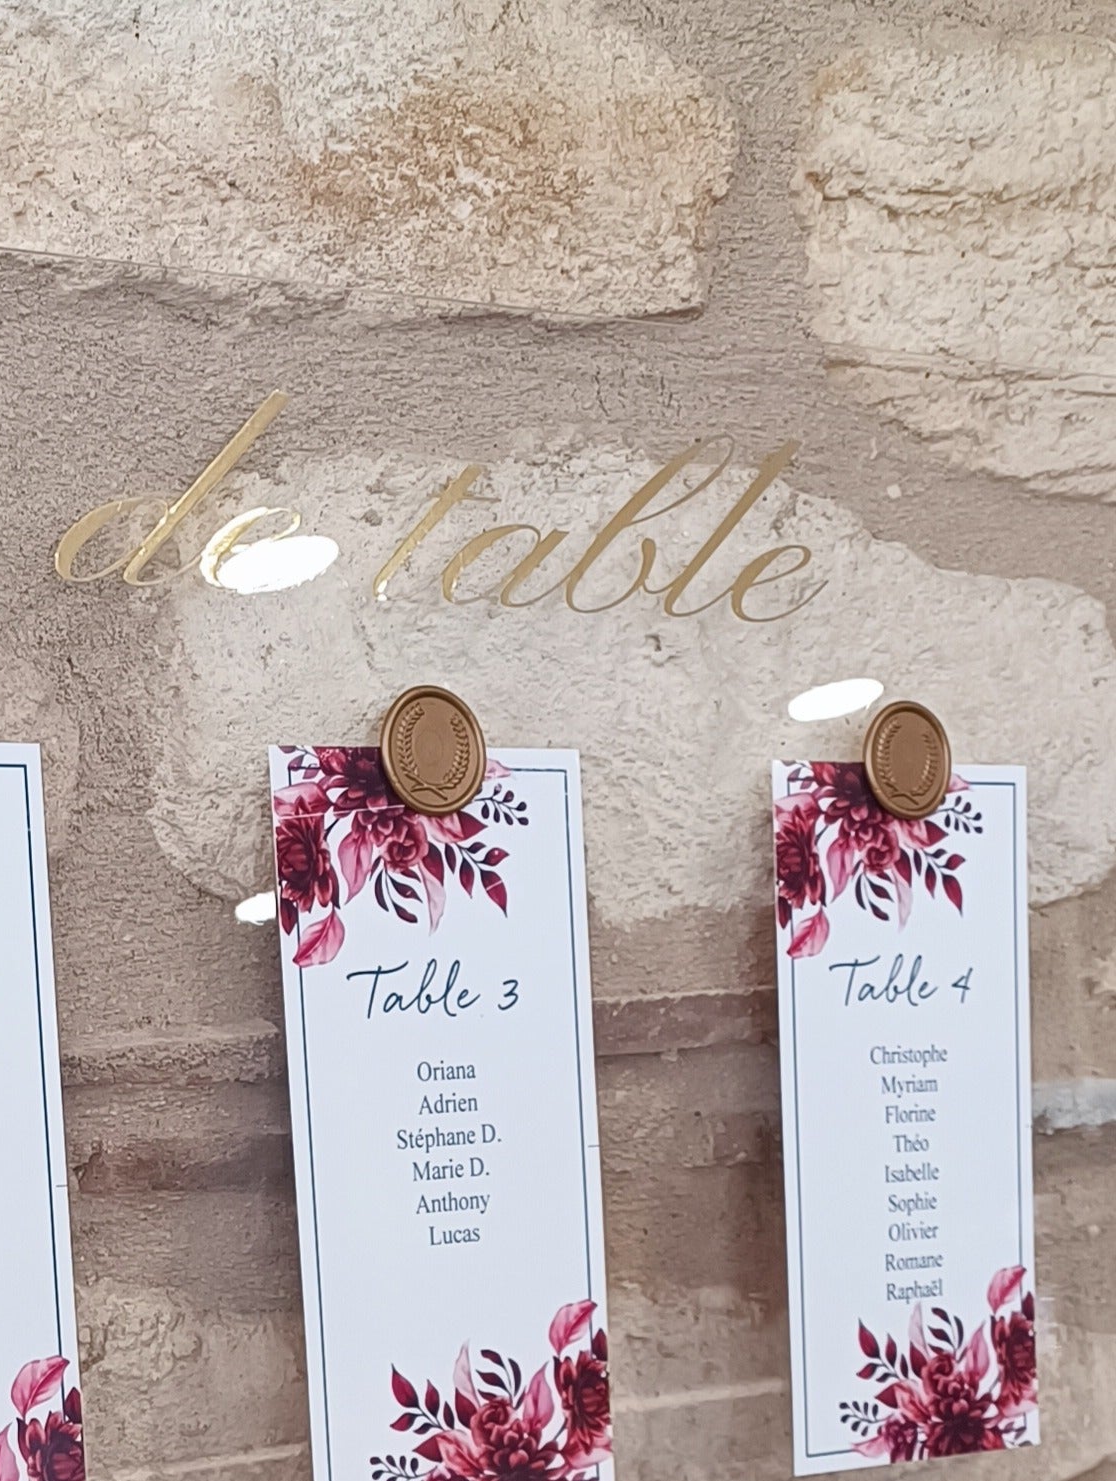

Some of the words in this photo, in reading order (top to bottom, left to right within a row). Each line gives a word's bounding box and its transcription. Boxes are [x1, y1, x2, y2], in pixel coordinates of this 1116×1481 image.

[54, 388, 309, 592] de
[372, 433, 828, 622] table
[346, 958, 481, 1019] Table
[497, 979, 519, 1011] 3
[829, 953, 938, 1007] Table
[951, 967, 973, 1004] 4
[870, 1044, 948, 1068] Christophe
[417, 1060, 476, 1082] Oriana
[881, 1074, 938, 1098] Myriam
[418, 1092, 478, 1115] Adrien
[885, 1104, 936, 1124] Florine
[397, 1126, 476, 1154] Stéphane
[481, 1124, 502, 1143] D.
[893, 1134, 929, 1153] Théo
[412, 1158, 464, 1182] Marie
[469, 1157, 490, 1177] D.
[885, 1162, 939, 1183] Isabelle
[416, 1191, 490, 1215] Anthony
[888, 1192, 937, 1216] Sophie
[429, 1226, 480, 1246] Lucas
[888, 1221, 939, 1242] Olivier
[885, 1254, 943, 1272] Romane
[886, 1278, 943, 1304] Raphaël
